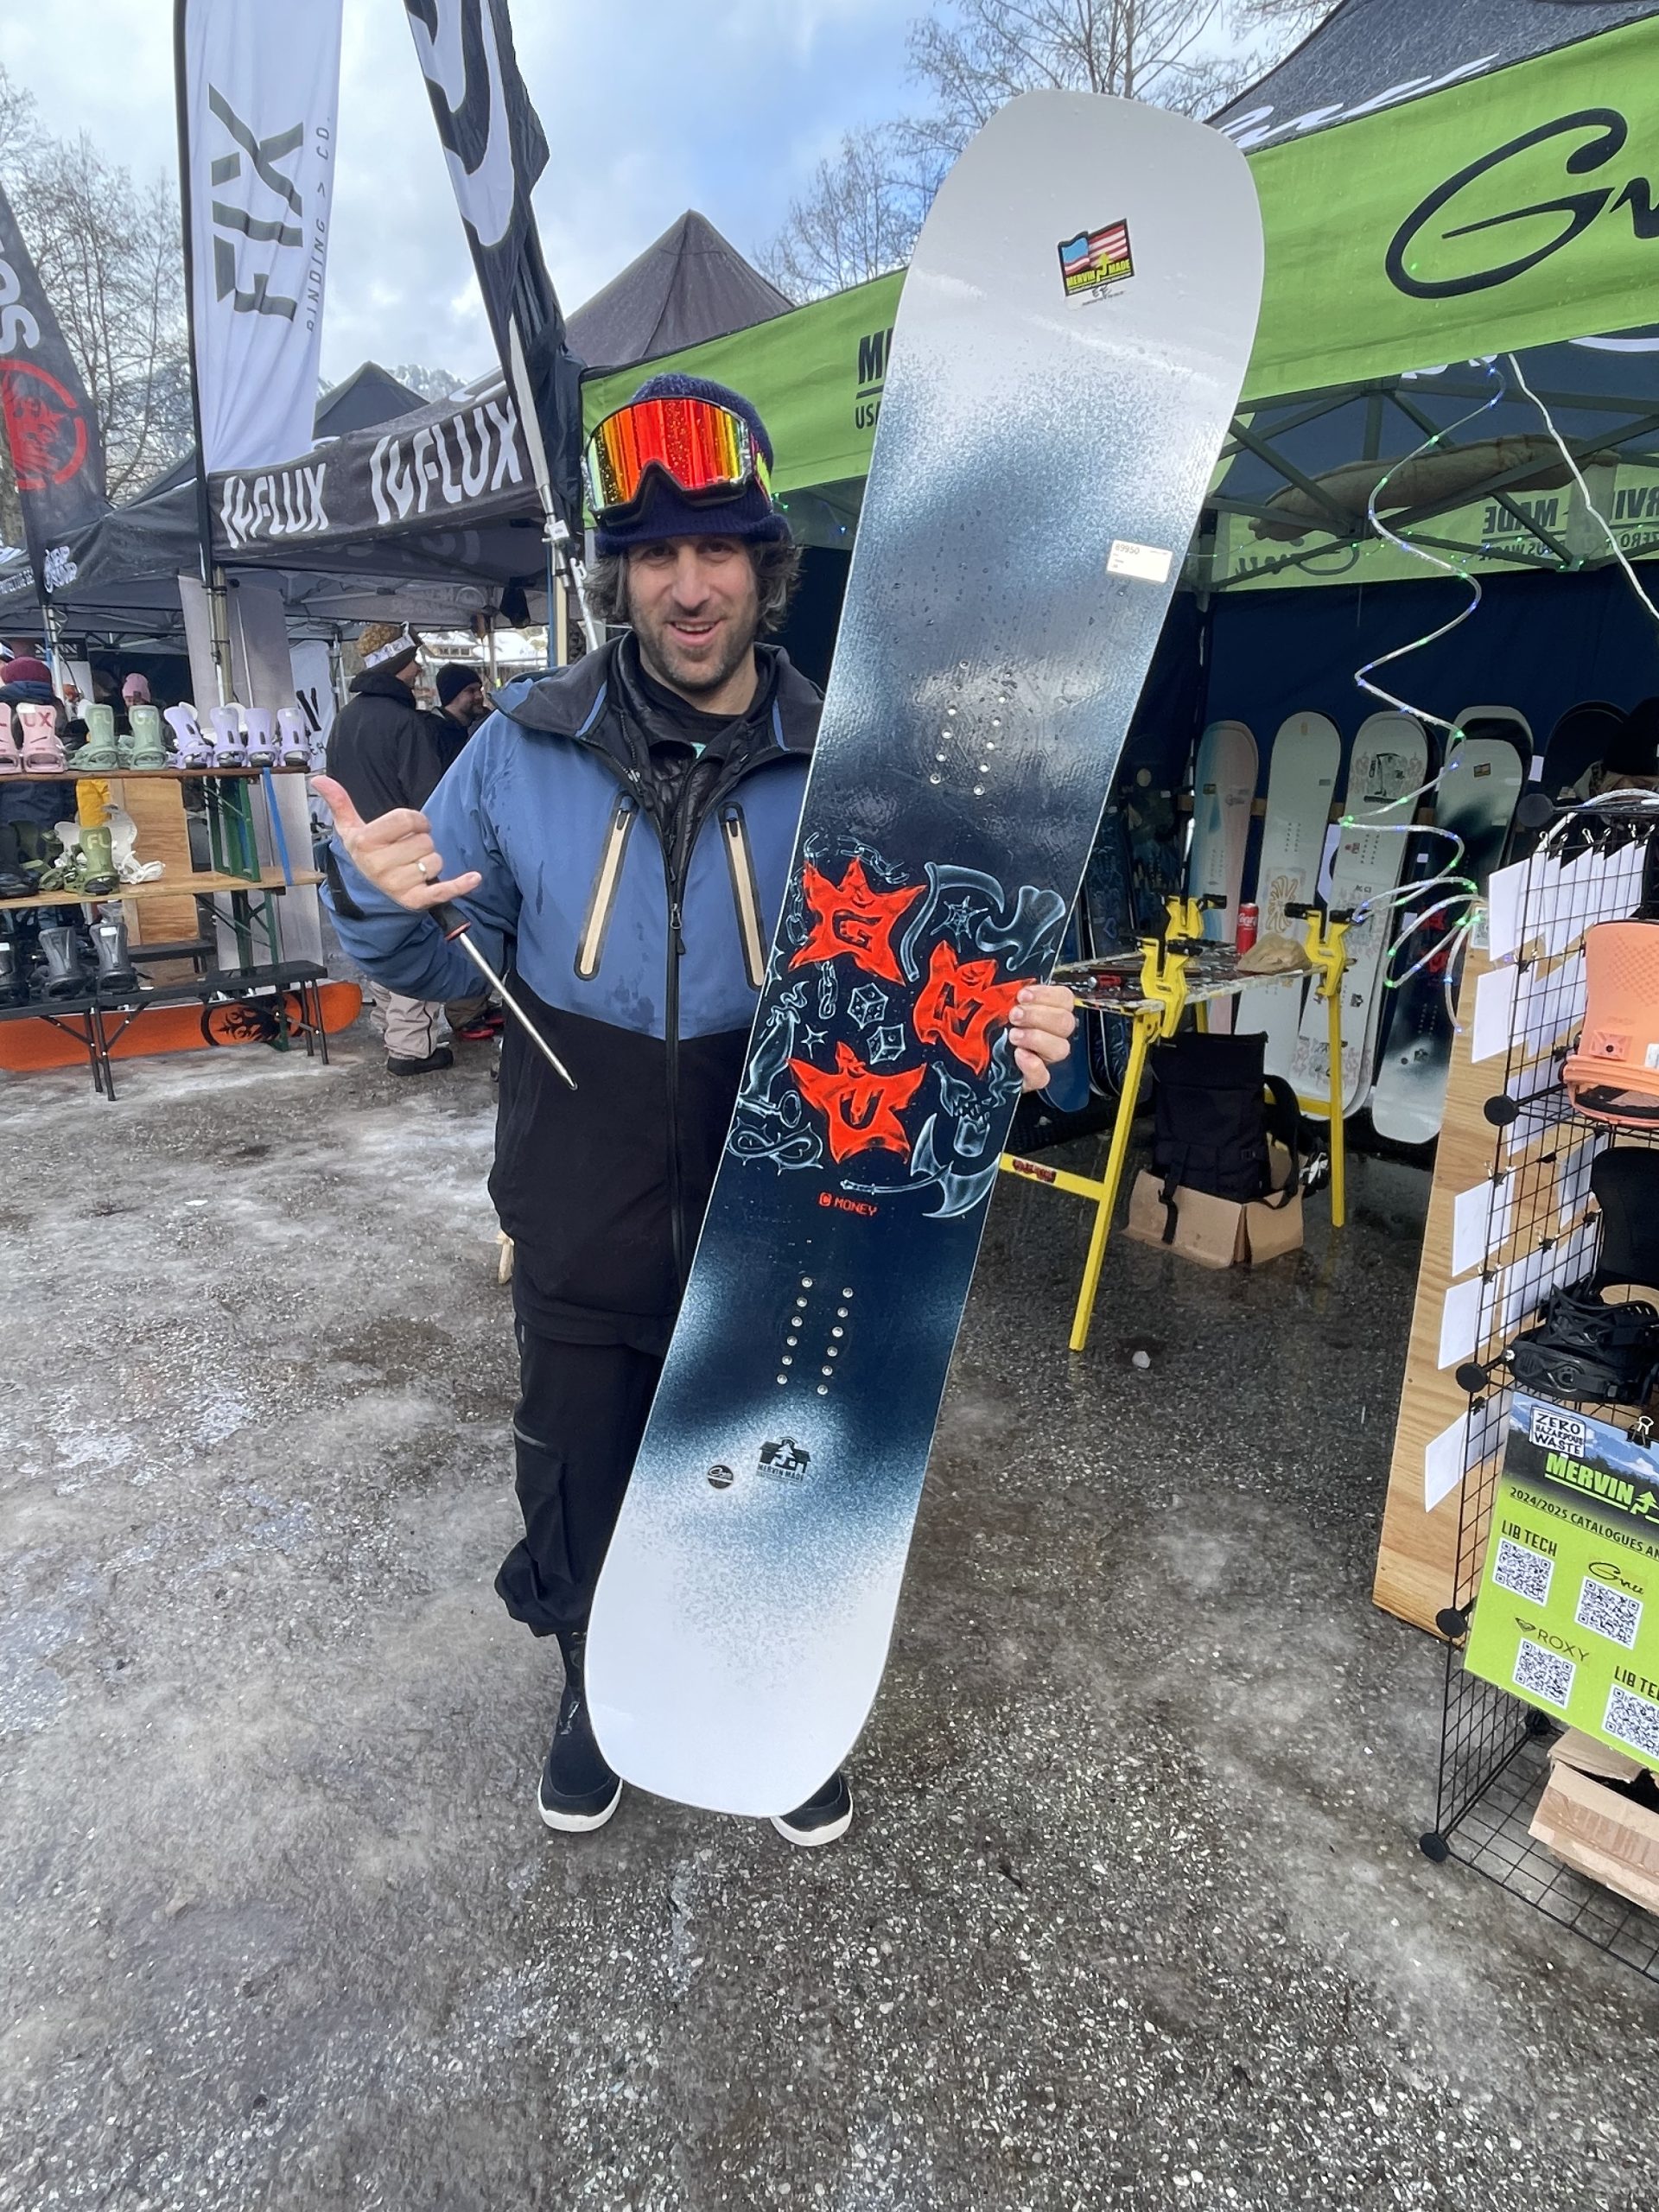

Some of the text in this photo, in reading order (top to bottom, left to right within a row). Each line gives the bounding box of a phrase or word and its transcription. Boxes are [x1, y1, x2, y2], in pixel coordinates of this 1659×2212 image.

[208, 83, 303, 322] FIX
[834, 1198, 877, 1217] MONEY
[1535, 1413, 1580, 1434] ZERO
[1534, 1432, 1580, 1455] WASTE
[1545, 1452, 1635, 1505] MERVIN
[1510, 1487, 1568, 1519] 2024/2025
[1570, 1513, 1643, 1552] CATALOGUES
[1501, 1519, 1558, 1557] LIB TECH
[1537, 1628, 1590, 1662] ROXY
[1614, 1665, 1659, 1700] LIB TE
